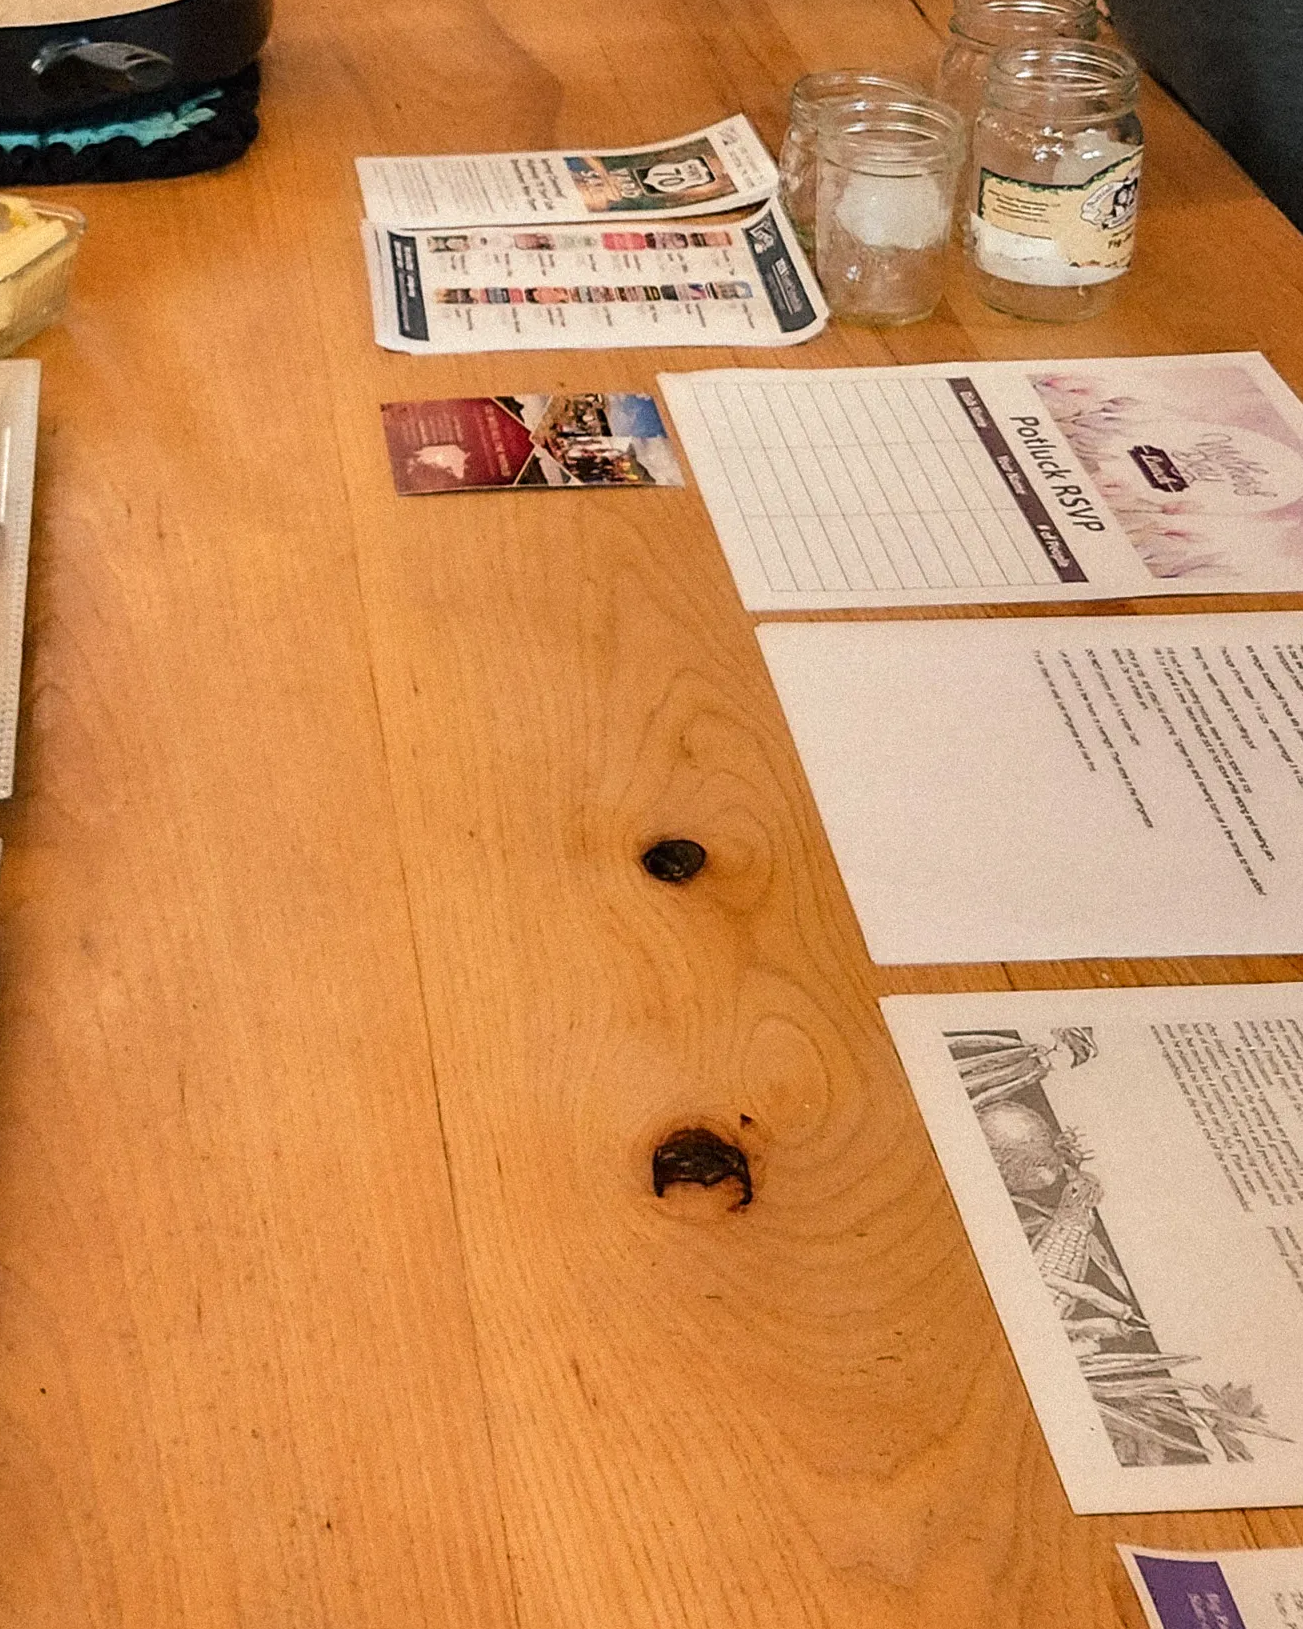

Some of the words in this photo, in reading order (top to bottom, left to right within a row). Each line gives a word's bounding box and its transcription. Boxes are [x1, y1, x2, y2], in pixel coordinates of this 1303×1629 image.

[652, 167, 686, 187] 70
[1008, 415, 1067, 480] Potluck
[1052, 484, 1107, 533] RSVP
